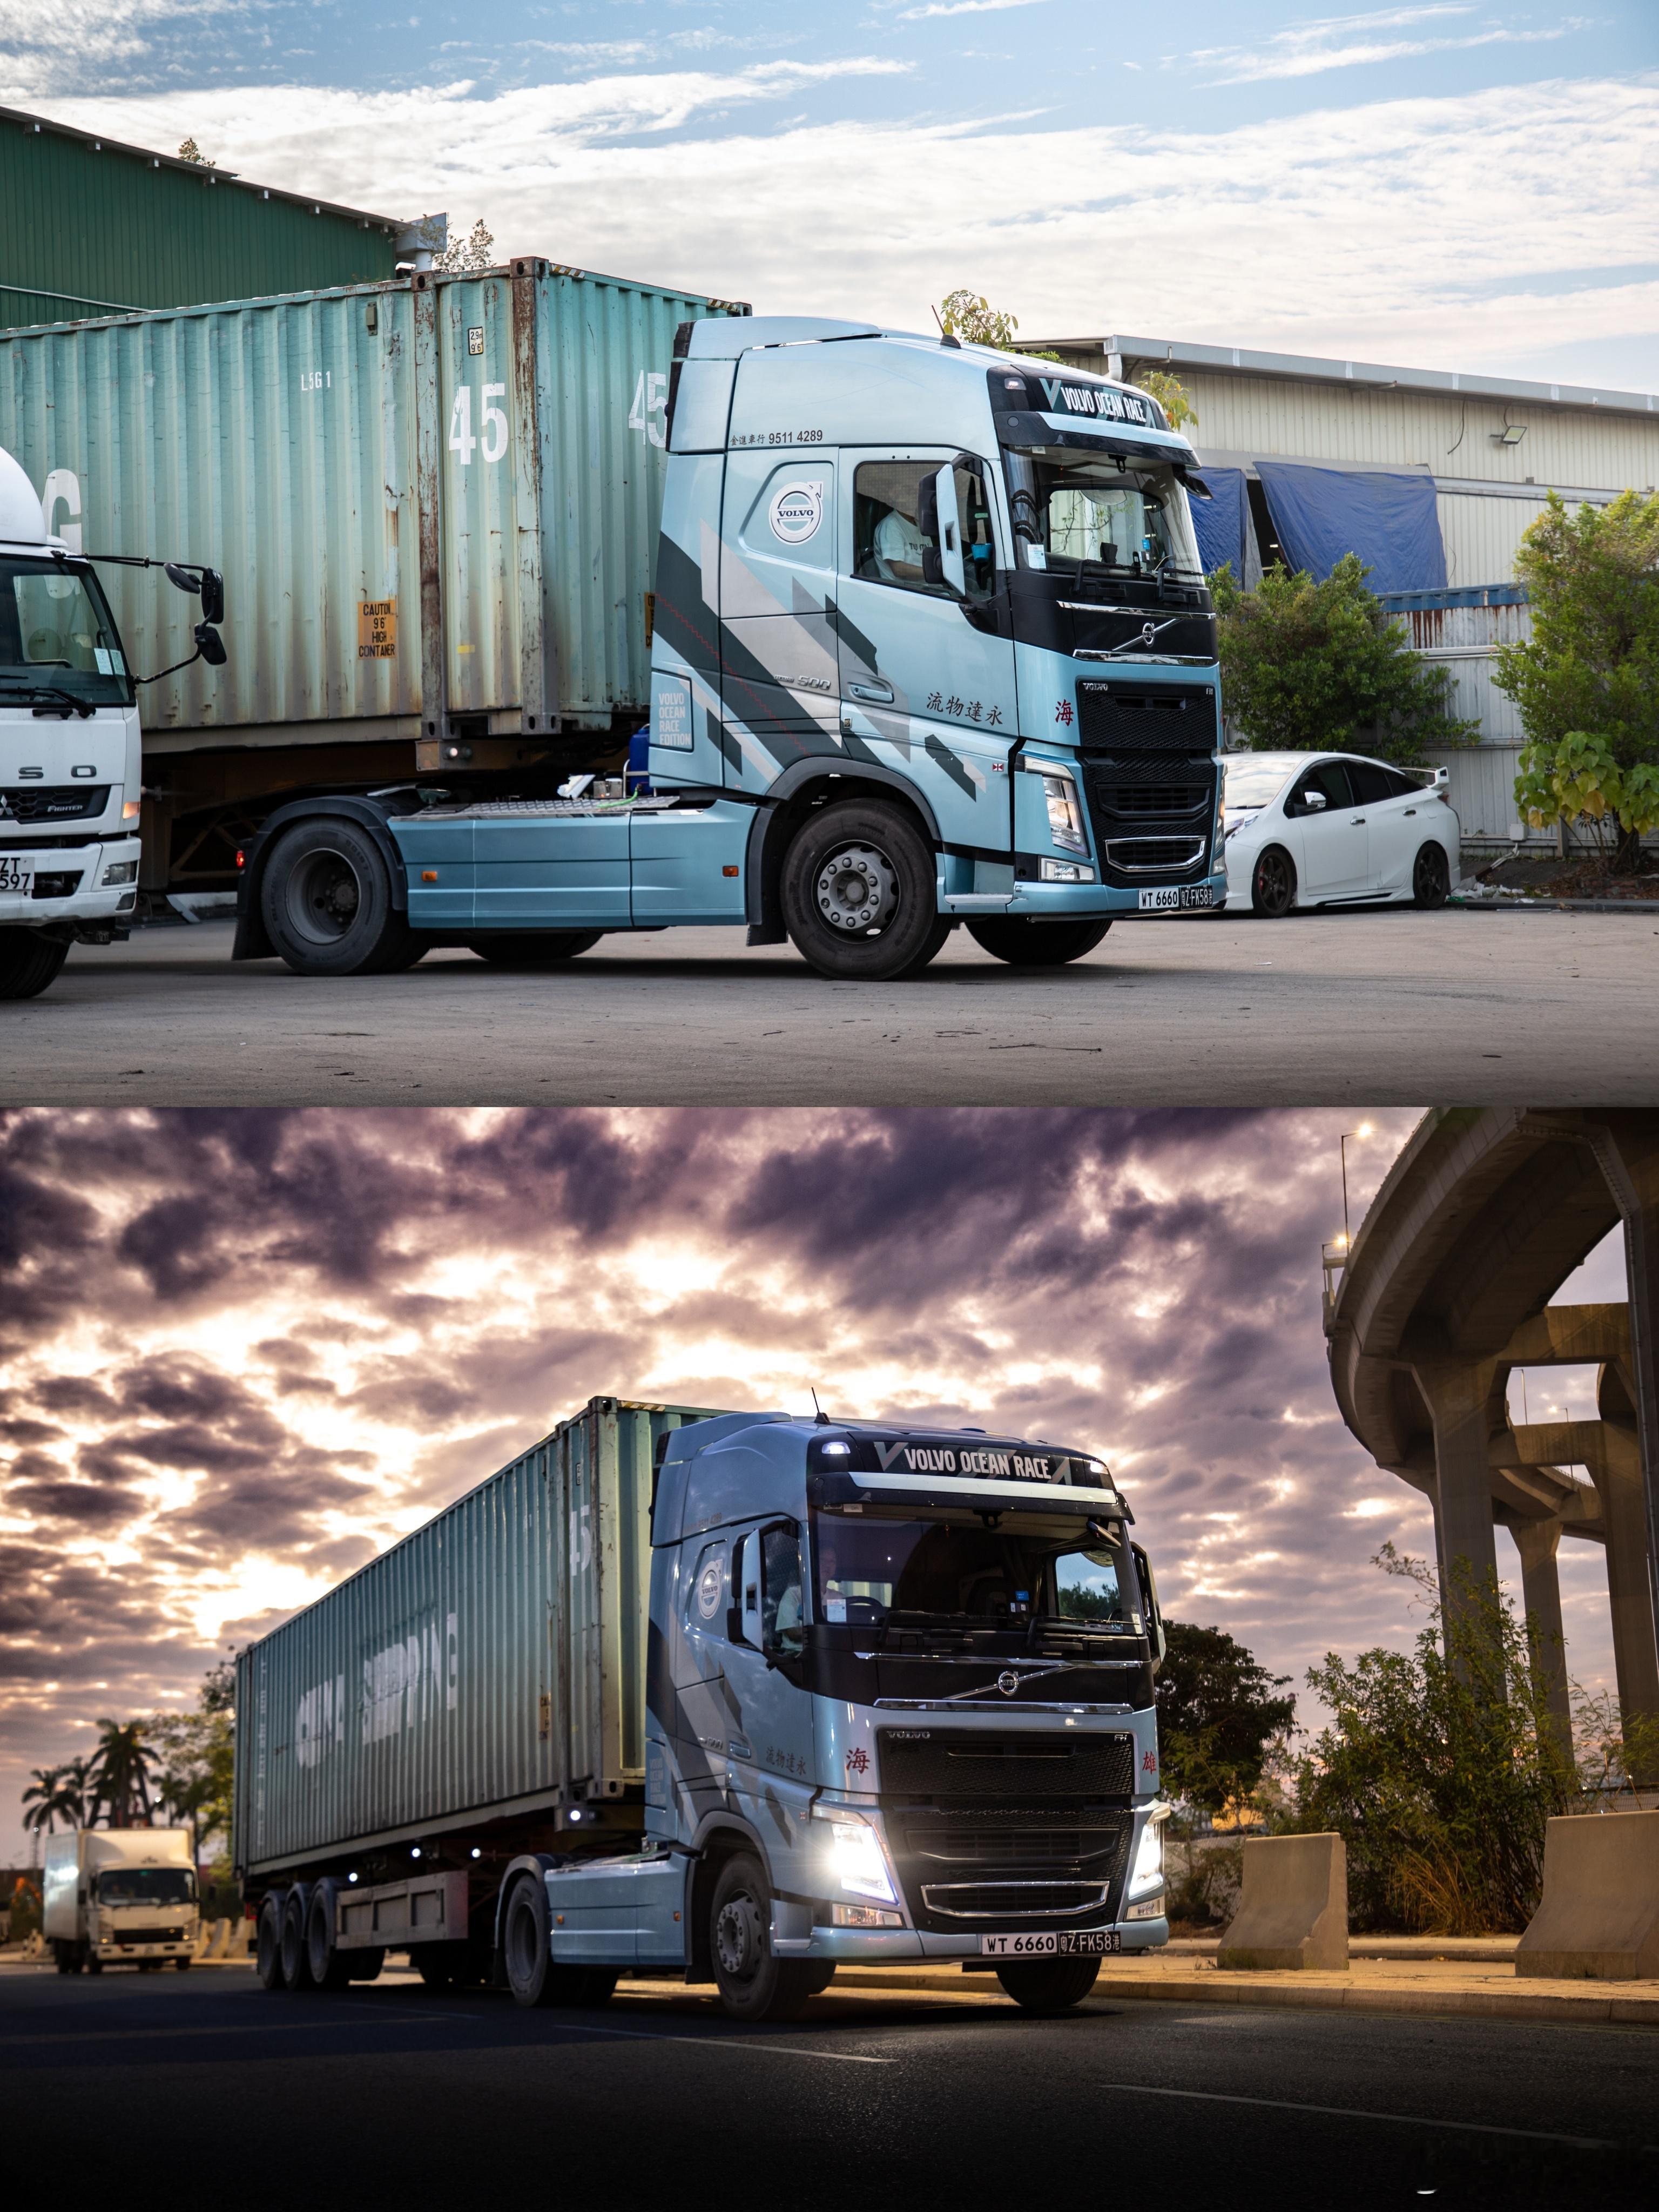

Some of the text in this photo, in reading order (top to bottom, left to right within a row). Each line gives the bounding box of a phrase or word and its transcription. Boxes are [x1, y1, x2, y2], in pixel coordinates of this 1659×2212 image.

[629, 369, 667, 448] 45
[1060, 387, 1147, 423] VOLVO OCEAN RACE
[449, 383, 508, 465] 45
[769, 431, 792, 444] 9511
[797, 430, 823, 442] 4289
[363, 603, 390, 616] CAUTION
[372, 631, 387, 643] HIGH
[359, 644, 395, 657] CONTAINER
[798, 675, 831, 691] 500
[1083, 683, 1108, 691] VOLVO
[658, 693, 684, 705] VOLVO
[659, 706, 685, 718] OCEAN
[1055, 699, 1074, 726] 海
[659, 720, 680, 732] RACE
[660, 733, 691, 746] EDITION
[1142, 891, 1177, 907] WT 6660
[904, 1448, 1051, 1479] VOLVO OCEAN RACE
[702, 1586, 718, 1594] VOLVO
[887, 1731, 930, 1739] VOLVO
[846, 1747, 871, 1774] 海
[1142, 1751, 1157, 1775] 雄
[987, 1936, 1054, 1953] WT 6660
